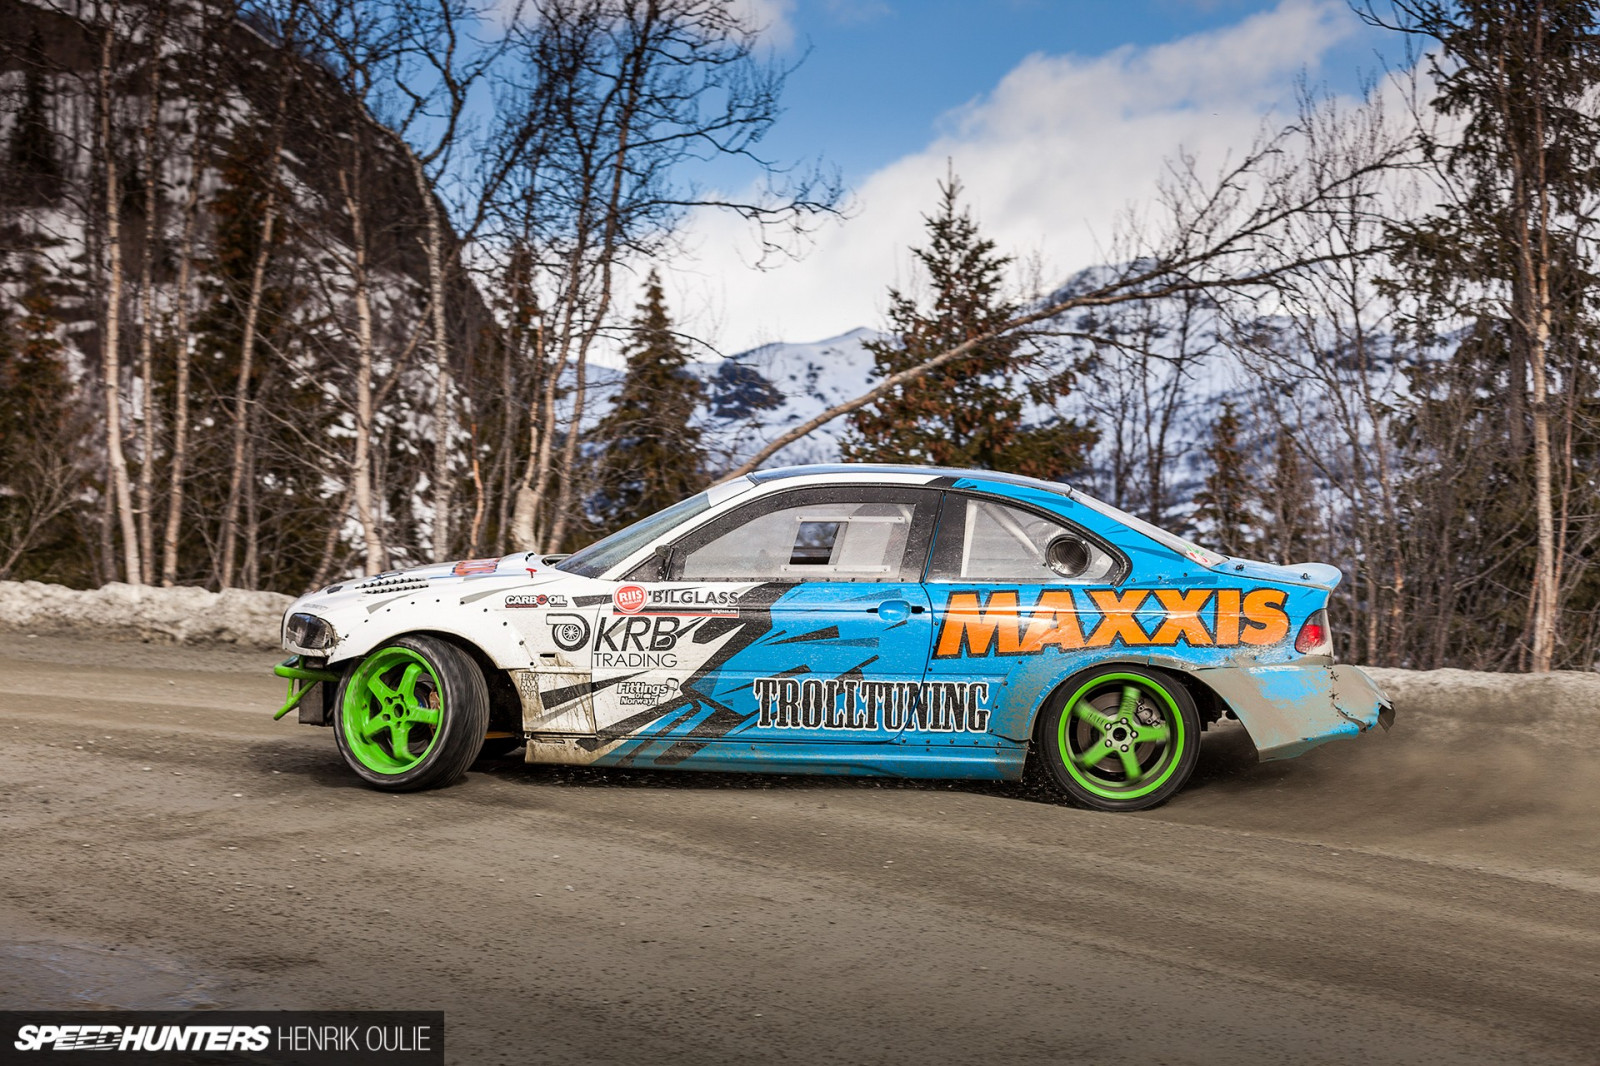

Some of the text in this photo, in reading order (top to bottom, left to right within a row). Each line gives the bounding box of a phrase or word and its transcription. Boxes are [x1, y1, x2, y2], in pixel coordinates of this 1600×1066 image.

[619, 590, 643, 602] RIIS
[652, 590, 738, 605] BILGLASS
[932, 588, 1291, 659] MAXXIS
[594, 616, 680, 652] KRB
[594, 652, 678, 668] TRADING
[617, 682, 668, 696] Fittings
[620, 696, 655, 706] Norway
[753, 678, 991, 733] TROLLTUNING
